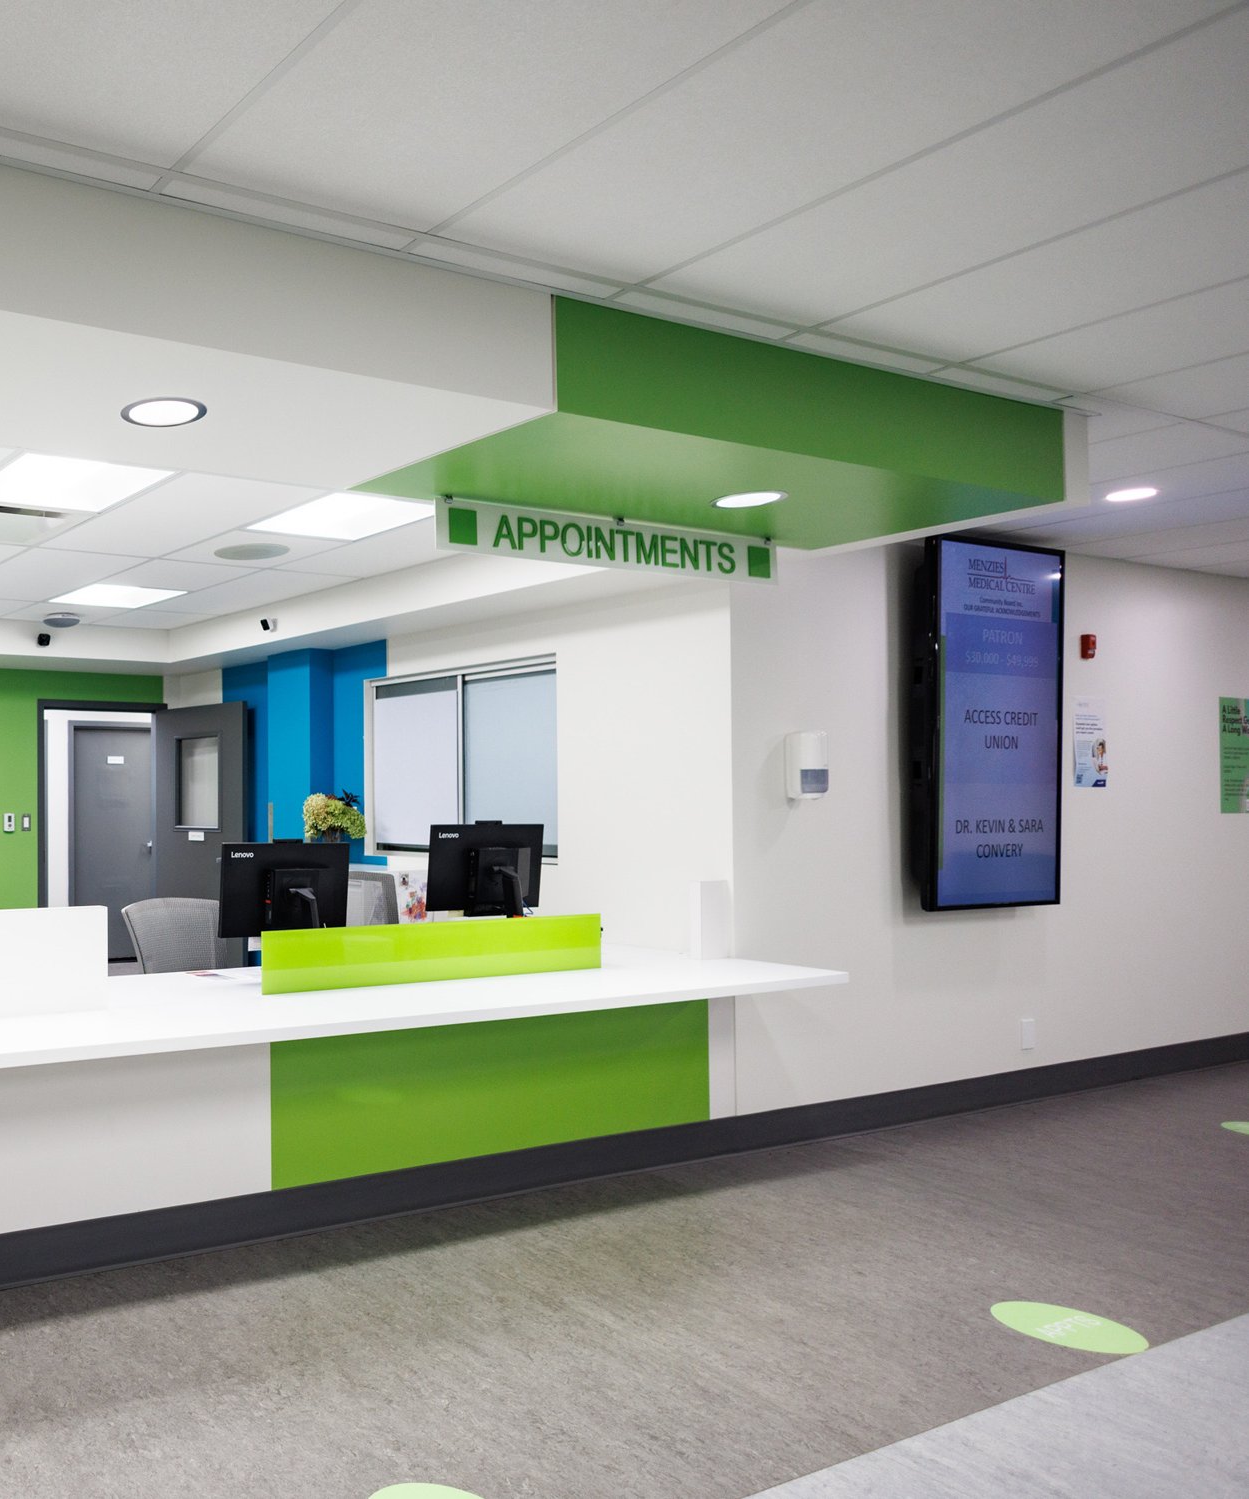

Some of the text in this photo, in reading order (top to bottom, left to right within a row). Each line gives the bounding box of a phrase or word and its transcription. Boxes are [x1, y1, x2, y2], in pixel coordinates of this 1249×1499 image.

[493, 514, 736, 575] APPOINTMENTS
[968, 558, 1005, 574] MENZIES
[968, 577, 1036, 595] MEDICAL CENTRE
[982, 629, 1023, 645] PATRON
[964, 709, 1038, 726] ACCESS CREDIT
[984, 735, 1019, 750] UNION
[955, 819, 1044, 834] DR. KEVIN & SARA
[230, 851, 254, 859] Lenovo
[976, 843, 1023, 858] CONVERY
